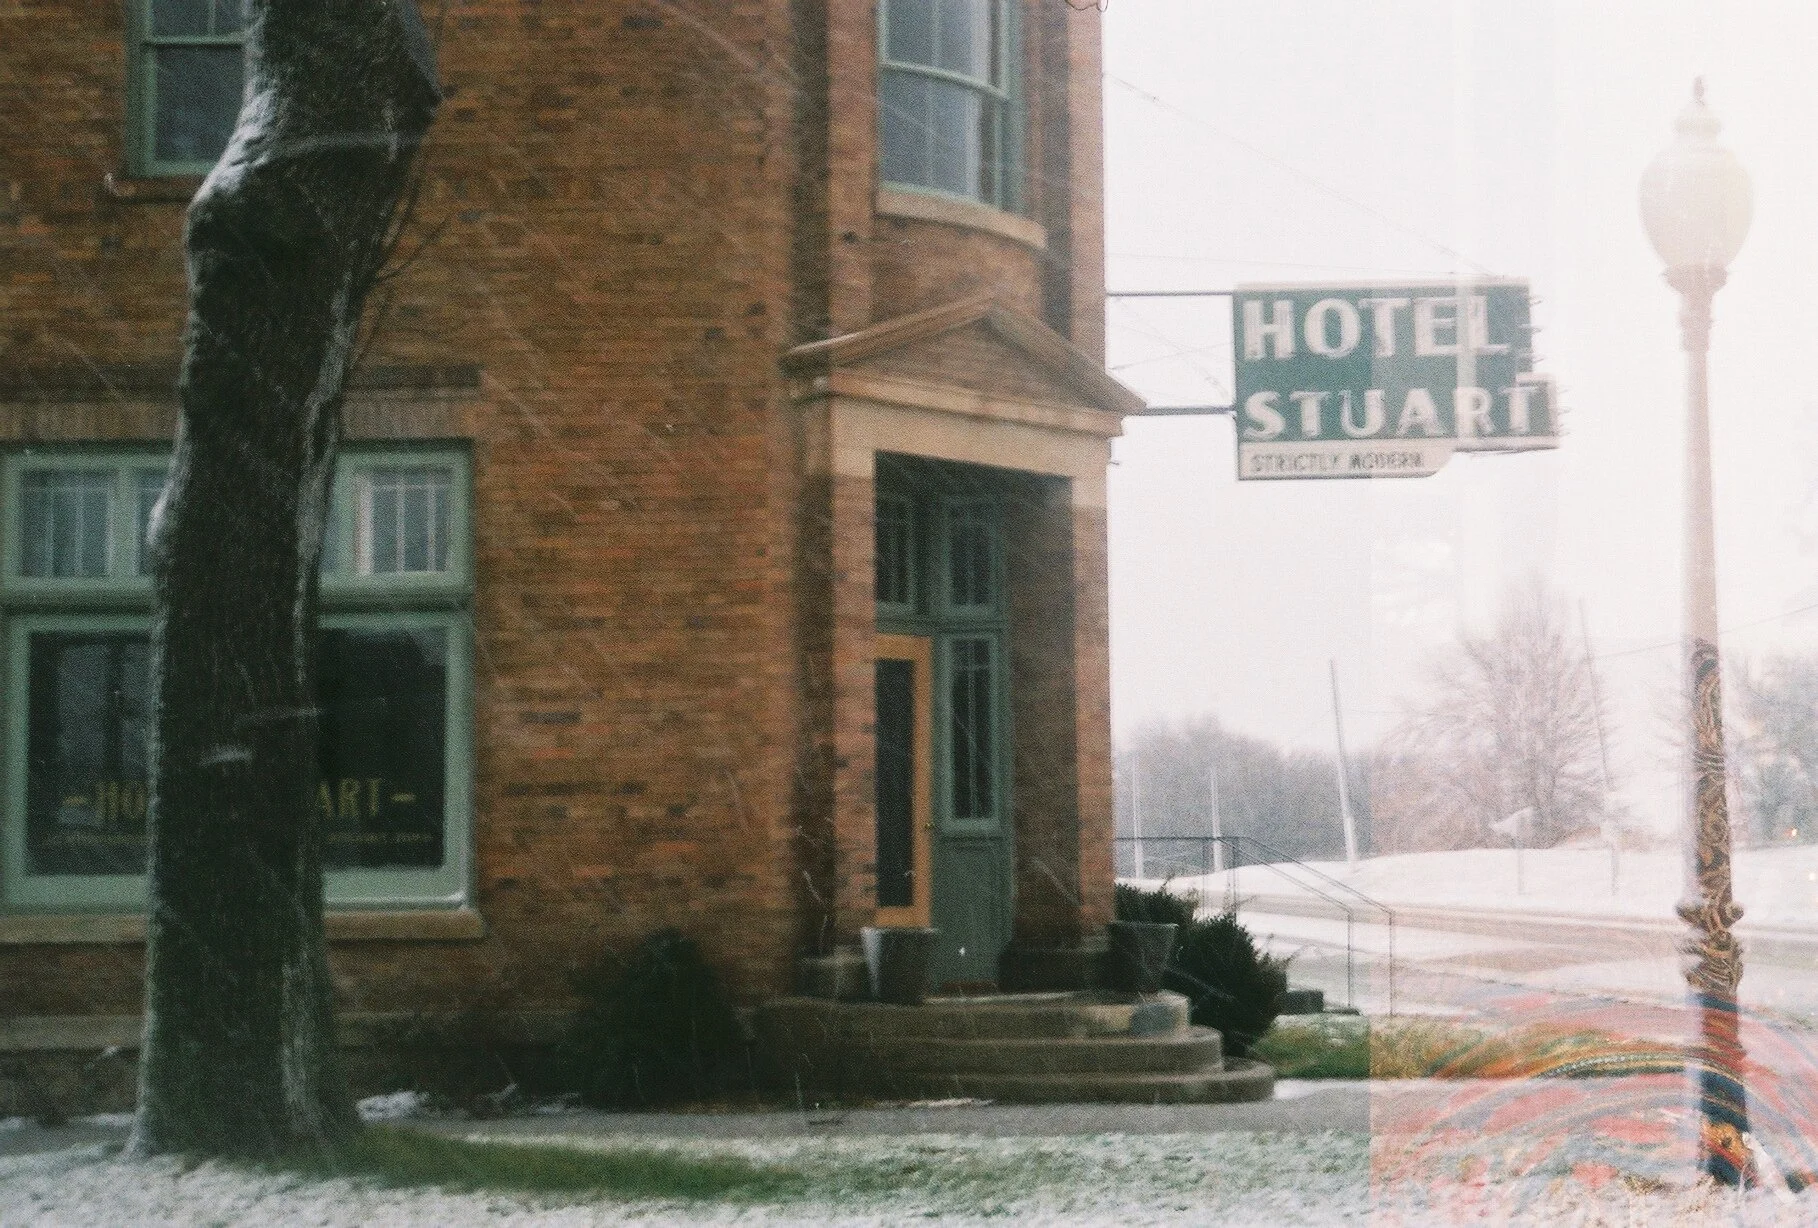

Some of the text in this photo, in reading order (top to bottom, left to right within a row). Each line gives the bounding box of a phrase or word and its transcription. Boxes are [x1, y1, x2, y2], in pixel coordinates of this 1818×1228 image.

[1242, 295, 1510, 359] HOTEL
[1243, 386, 1539, 440] STUART
[1250, 453, 1341, 473] STRICTLY
[317, 777, 385, 819] ART
